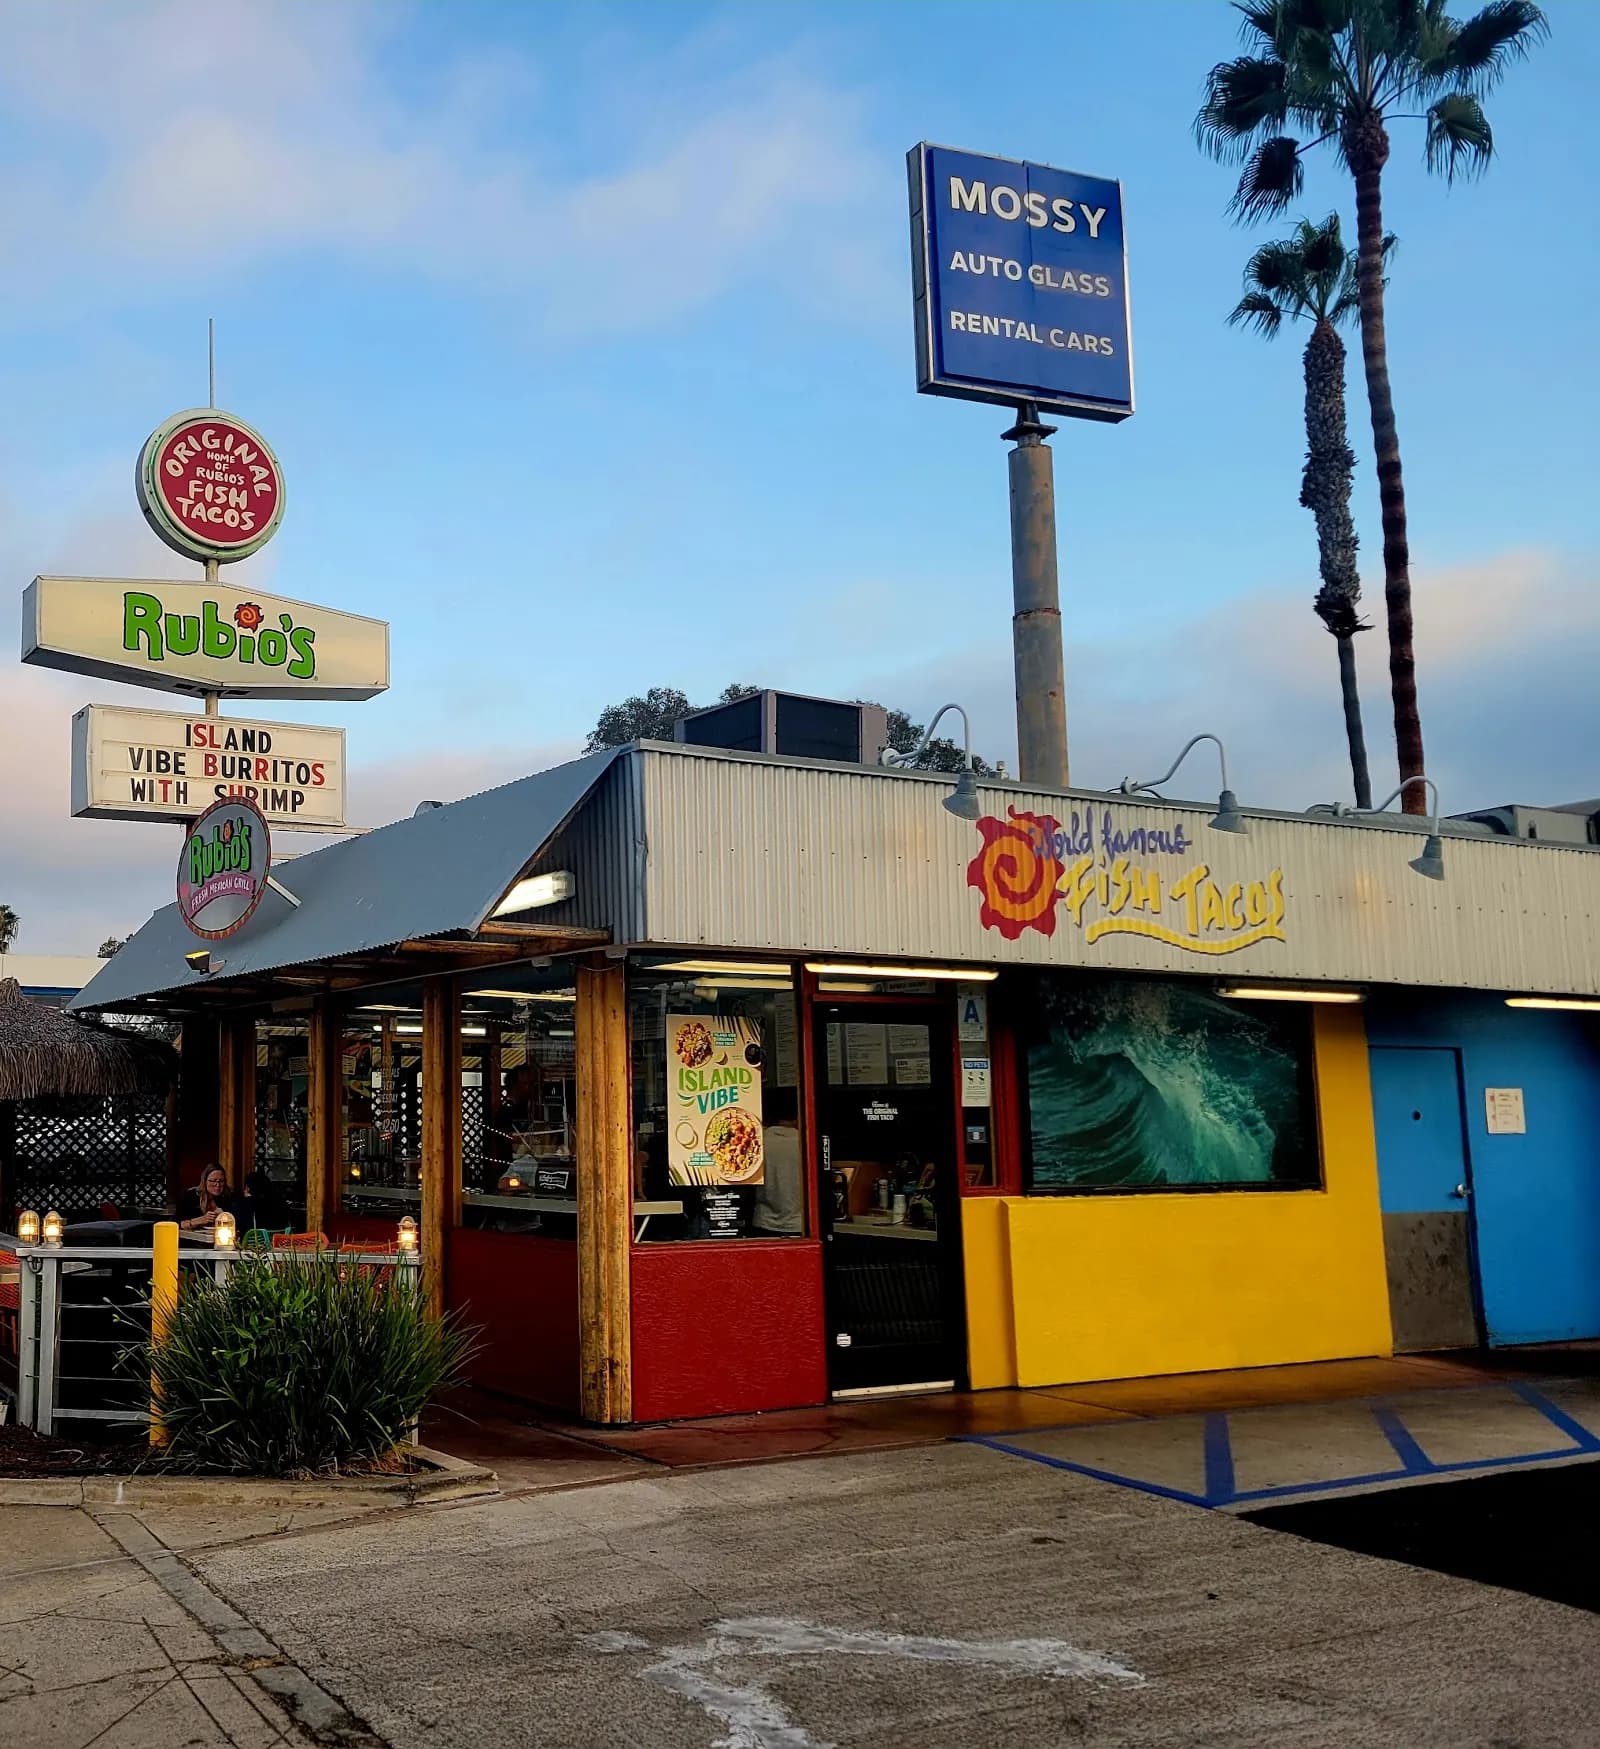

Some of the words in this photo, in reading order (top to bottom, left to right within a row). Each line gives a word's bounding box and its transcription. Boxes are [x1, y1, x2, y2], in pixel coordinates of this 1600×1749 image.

[950, 176, 1106, 238] MOSSY
[950, 251, 1022, 281] AUTO
[1028, 264, 1110, 297] GLASS
[950, 310, 1044, 344] RENTAL
[1049, 328, 1114, 356] CARS
[165, 429, 272, 497] ORIGINAL
[207, 451, 236, 464] HOME
[215, 462, 229, 472] OF
[196, 467, 245, 485] RUBIO'S
[189, 480, 248, 510] FISH
[176, 497, 255, 531] TACOS
[185, 723, 272, 753] ISLAND
[129, 747, 187, 775] VIBE
[203, 753, 326, 786] BURRITOS
[130, 778, 188, 805] WITH
[1101, 810, 1192, 862] famous
[191, 888, 209, 910] FRESH
[209, 879, 233, 898] MEXICAN
[234, 877, 250, 891] GRILL
[1169, 864, 1286, 937] TACOS
[963, 999, 980, 1023] A
[678, 1066, 753, 1092] ISLAND
[695, 1086, 739, 1115] VIBE
